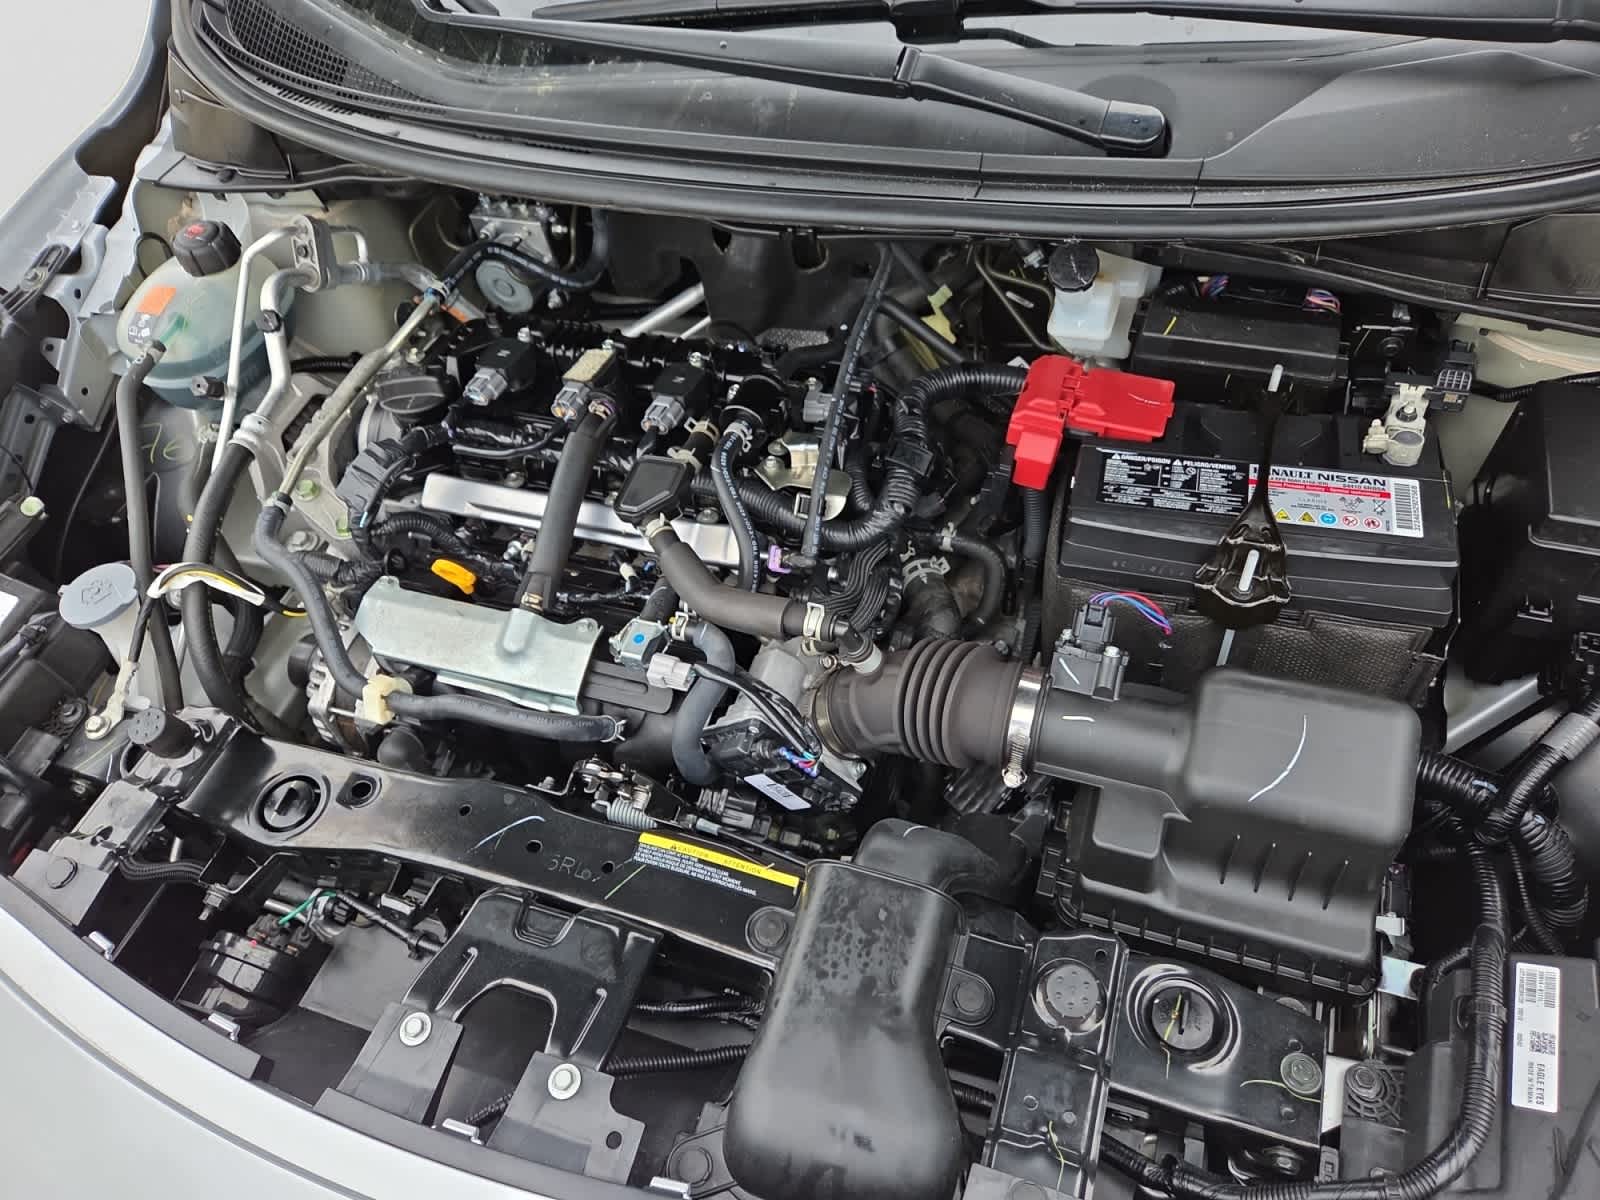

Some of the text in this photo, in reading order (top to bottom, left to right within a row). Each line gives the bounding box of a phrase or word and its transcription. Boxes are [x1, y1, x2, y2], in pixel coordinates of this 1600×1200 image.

[1183, 460, 1237, 471] PELIGRO/VENENO
[1318, 473, 1386, 487] NISSAN
[723, 859, 761, 873] ATTENTION
[1536, 1064, 1545, 1105] EAGLE EYES
